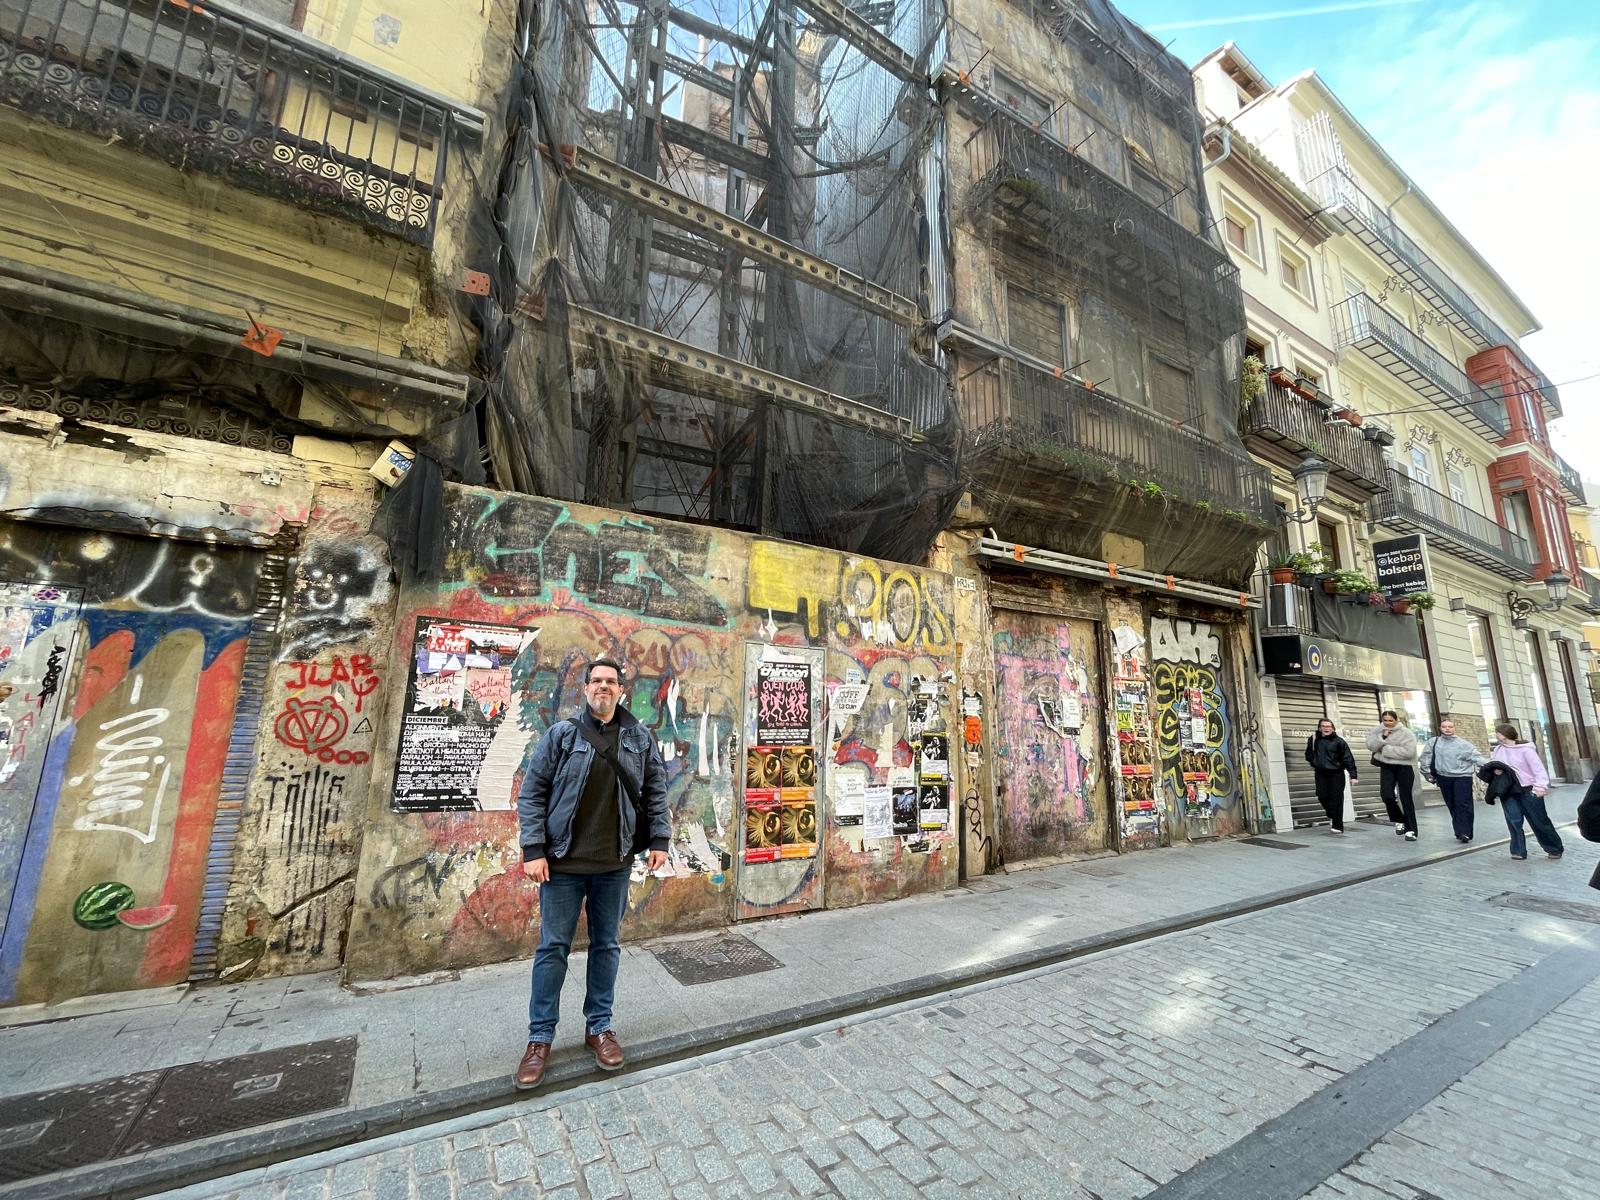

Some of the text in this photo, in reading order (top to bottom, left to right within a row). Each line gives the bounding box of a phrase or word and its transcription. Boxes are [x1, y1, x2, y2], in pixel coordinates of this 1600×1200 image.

[1387, 553, 1421, 564] kebap
[1378, 562, 1423, 576] bolsería
[470, 674, 511, 692] Ballant
[471, 687, 505, 701] Ballant
